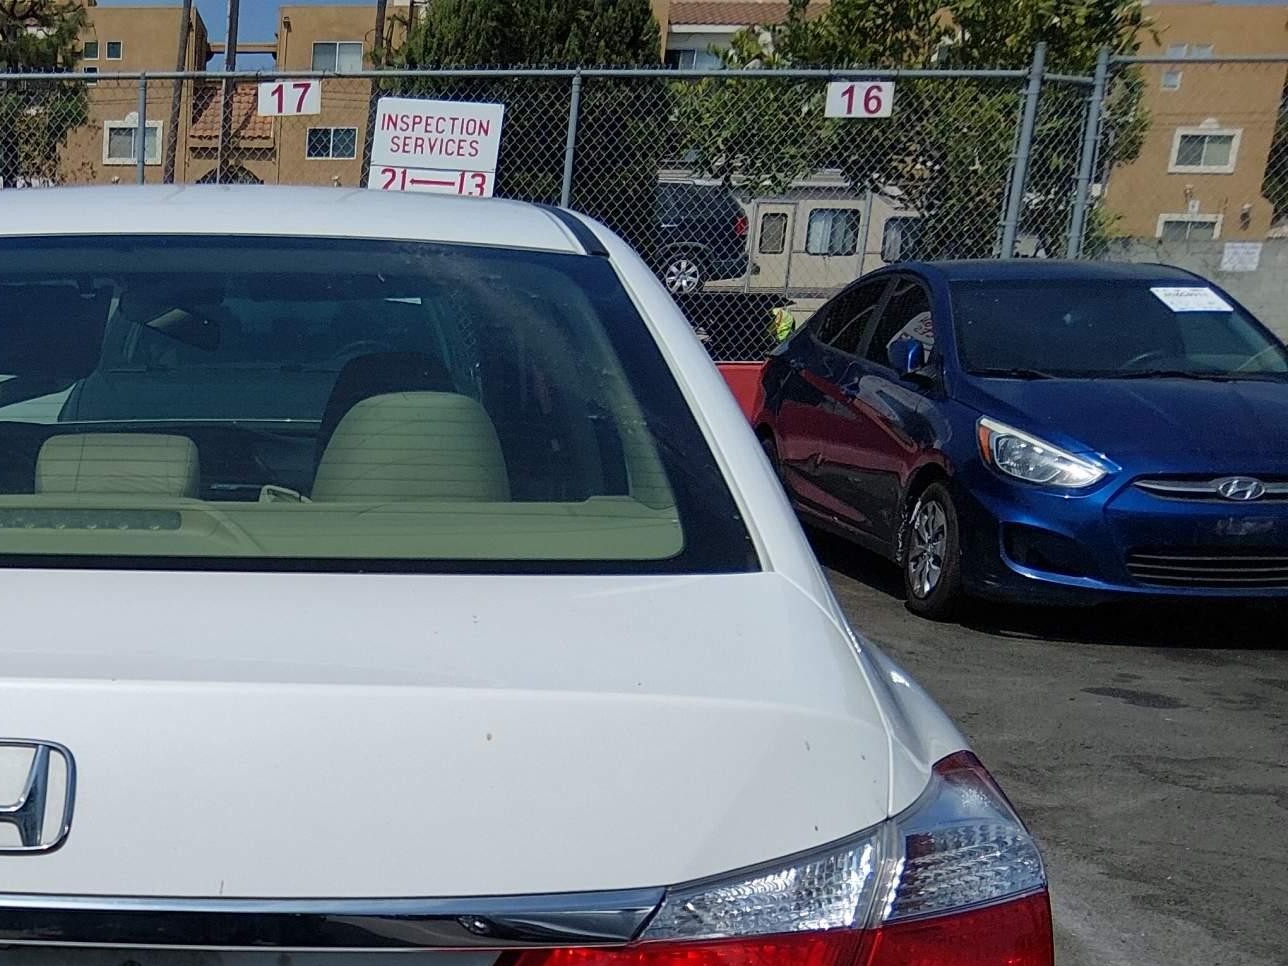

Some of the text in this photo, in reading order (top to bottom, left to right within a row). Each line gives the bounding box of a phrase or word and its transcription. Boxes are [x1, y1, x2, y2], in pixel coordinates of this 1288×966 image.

[270, 82, 312, 114] 17
[840, 84, 883, 116] 16
[380, 112, 491, 137] INSPECTION
[389, 135, 480, 158] SERVICES
